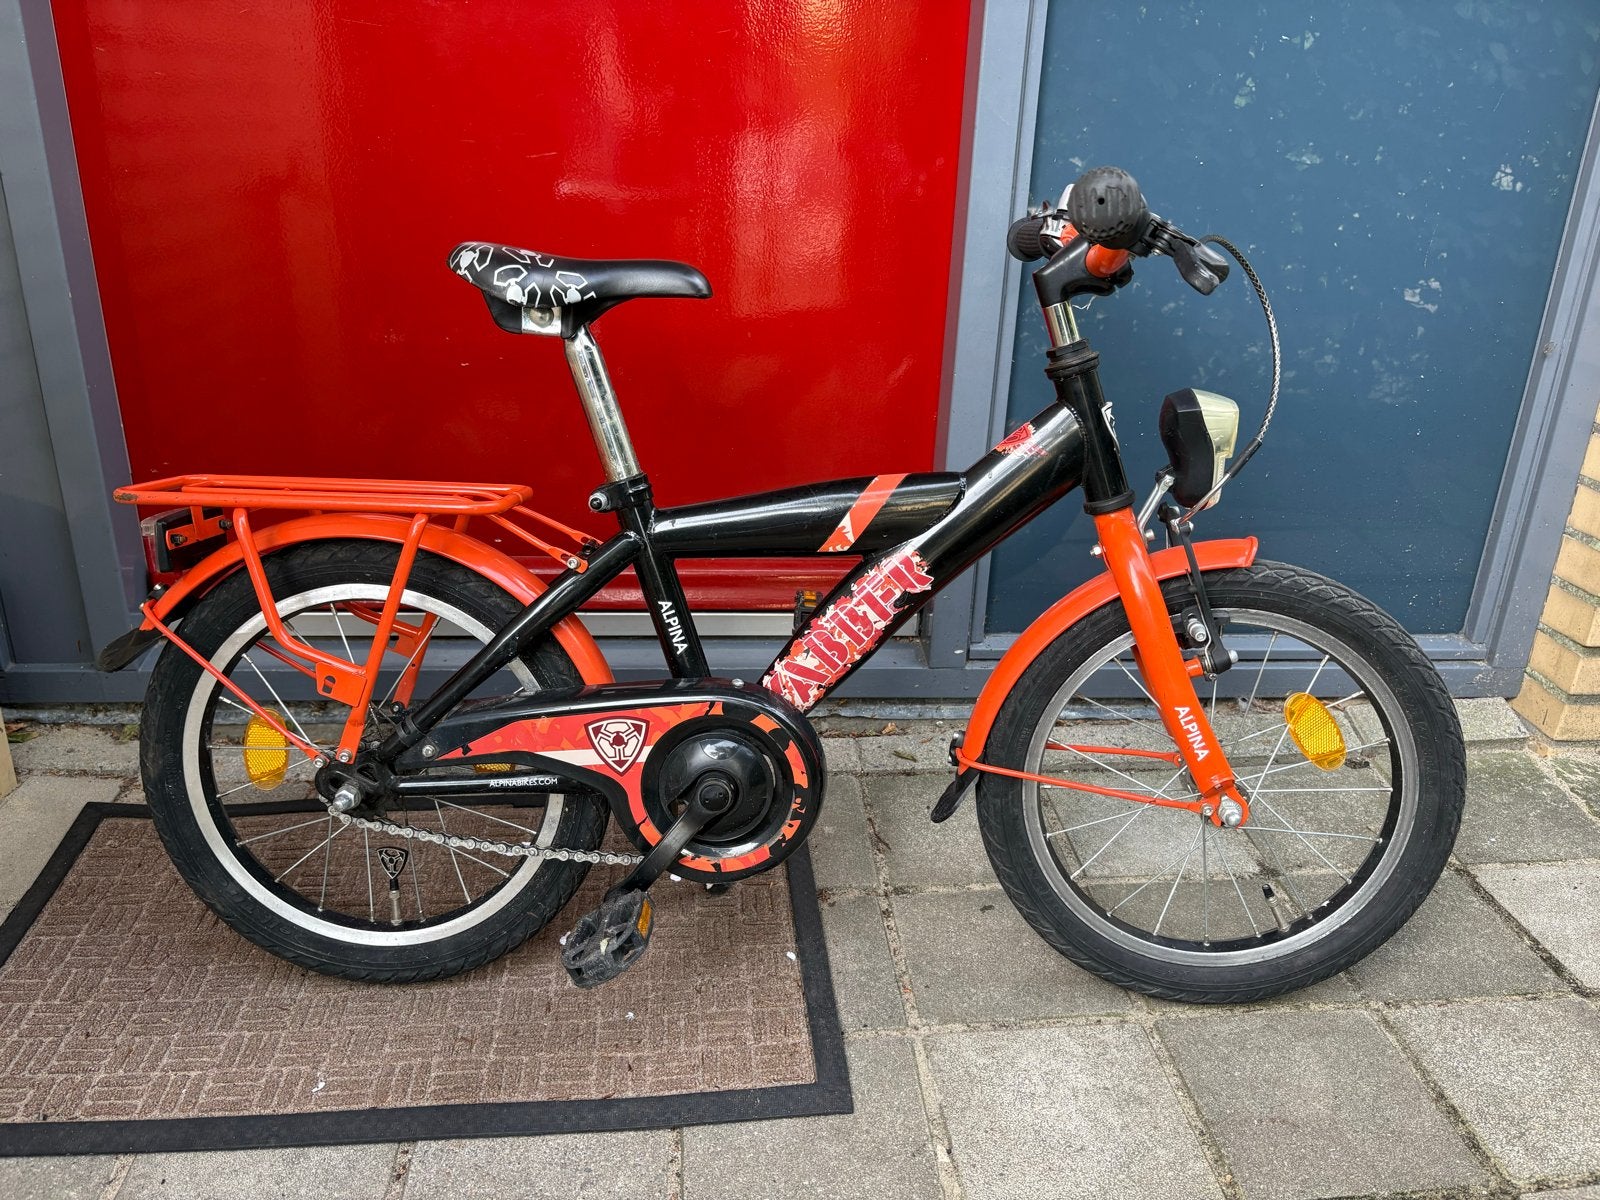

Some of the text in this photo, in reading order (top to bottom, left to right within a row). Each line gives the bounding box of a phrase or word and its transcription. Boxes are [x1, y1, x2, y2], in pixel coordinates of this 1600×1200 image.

[658, 601, 688, 654] ALPINA
[769, 553, 934, 704] ABBER
[1174, 707, 1209, 761] ALPINA
[489, 777, 558, 787] ALPINABIKES.COM
